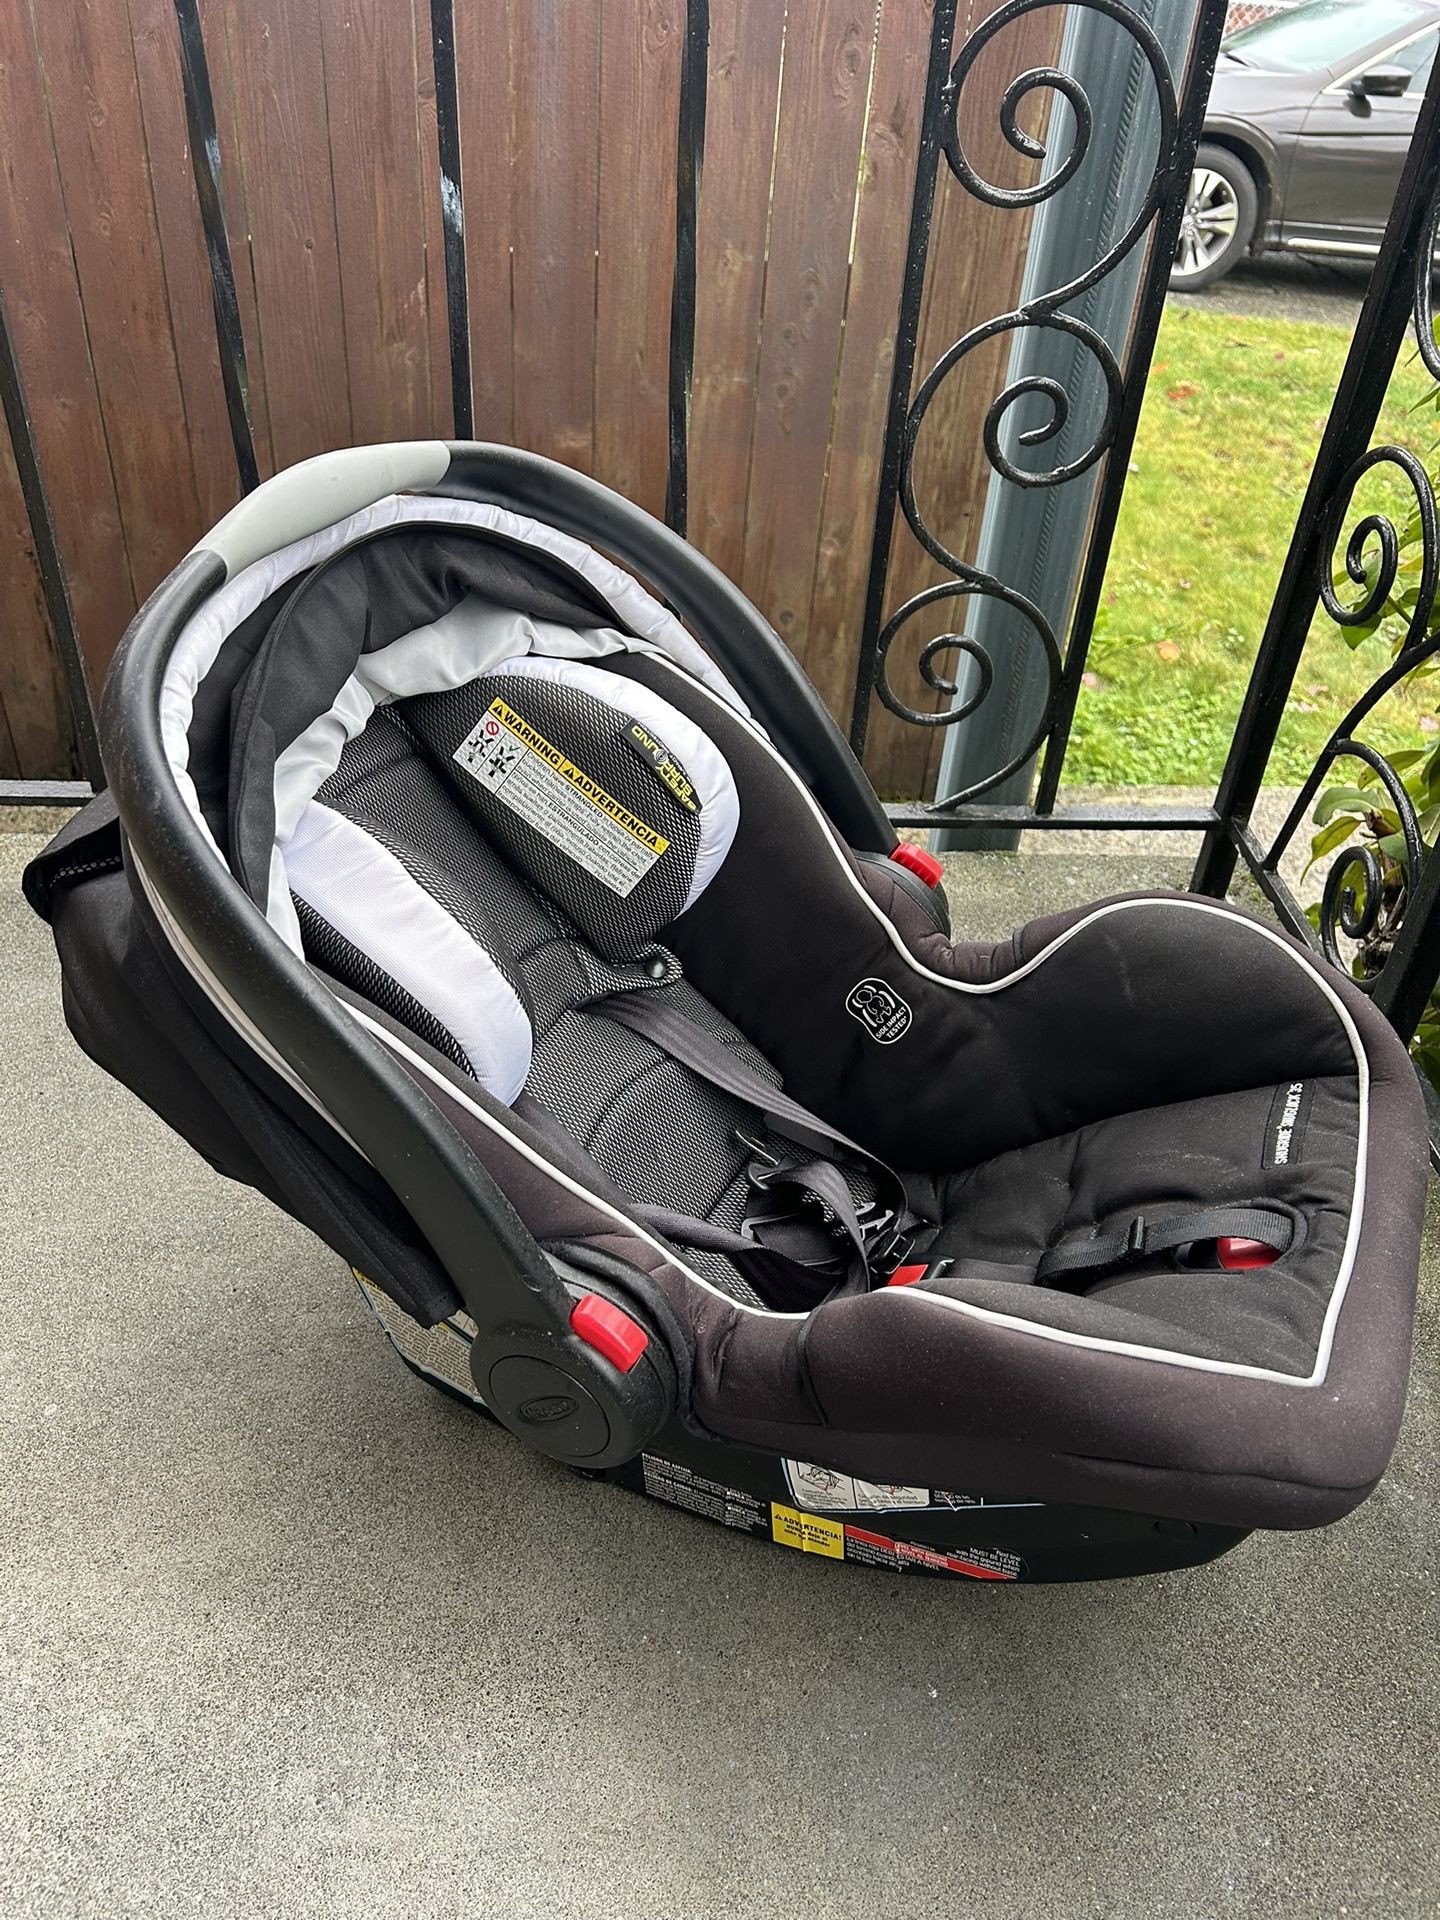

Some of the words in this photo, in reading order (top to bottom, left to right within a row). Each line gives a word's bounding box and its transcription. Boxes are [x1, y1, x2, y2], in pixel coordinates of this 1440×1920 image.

[501, 711, 561, 764] WARNING
[564, 783, 603, 818] STRANGLED
[654, 762, 697, 811] SAFETY
[547, 801, 599, 846] ESTRANGULADO
[573, 772, 659, 847] ADVERTENCIA
[876, 1025, 888, 1038] SIDE
[887, 1006, 906, 1027] IMPACT
[1290, 1082, 1303, 1093] 35
[783, 1516, 841, 1540] ADVERTENCIA!
